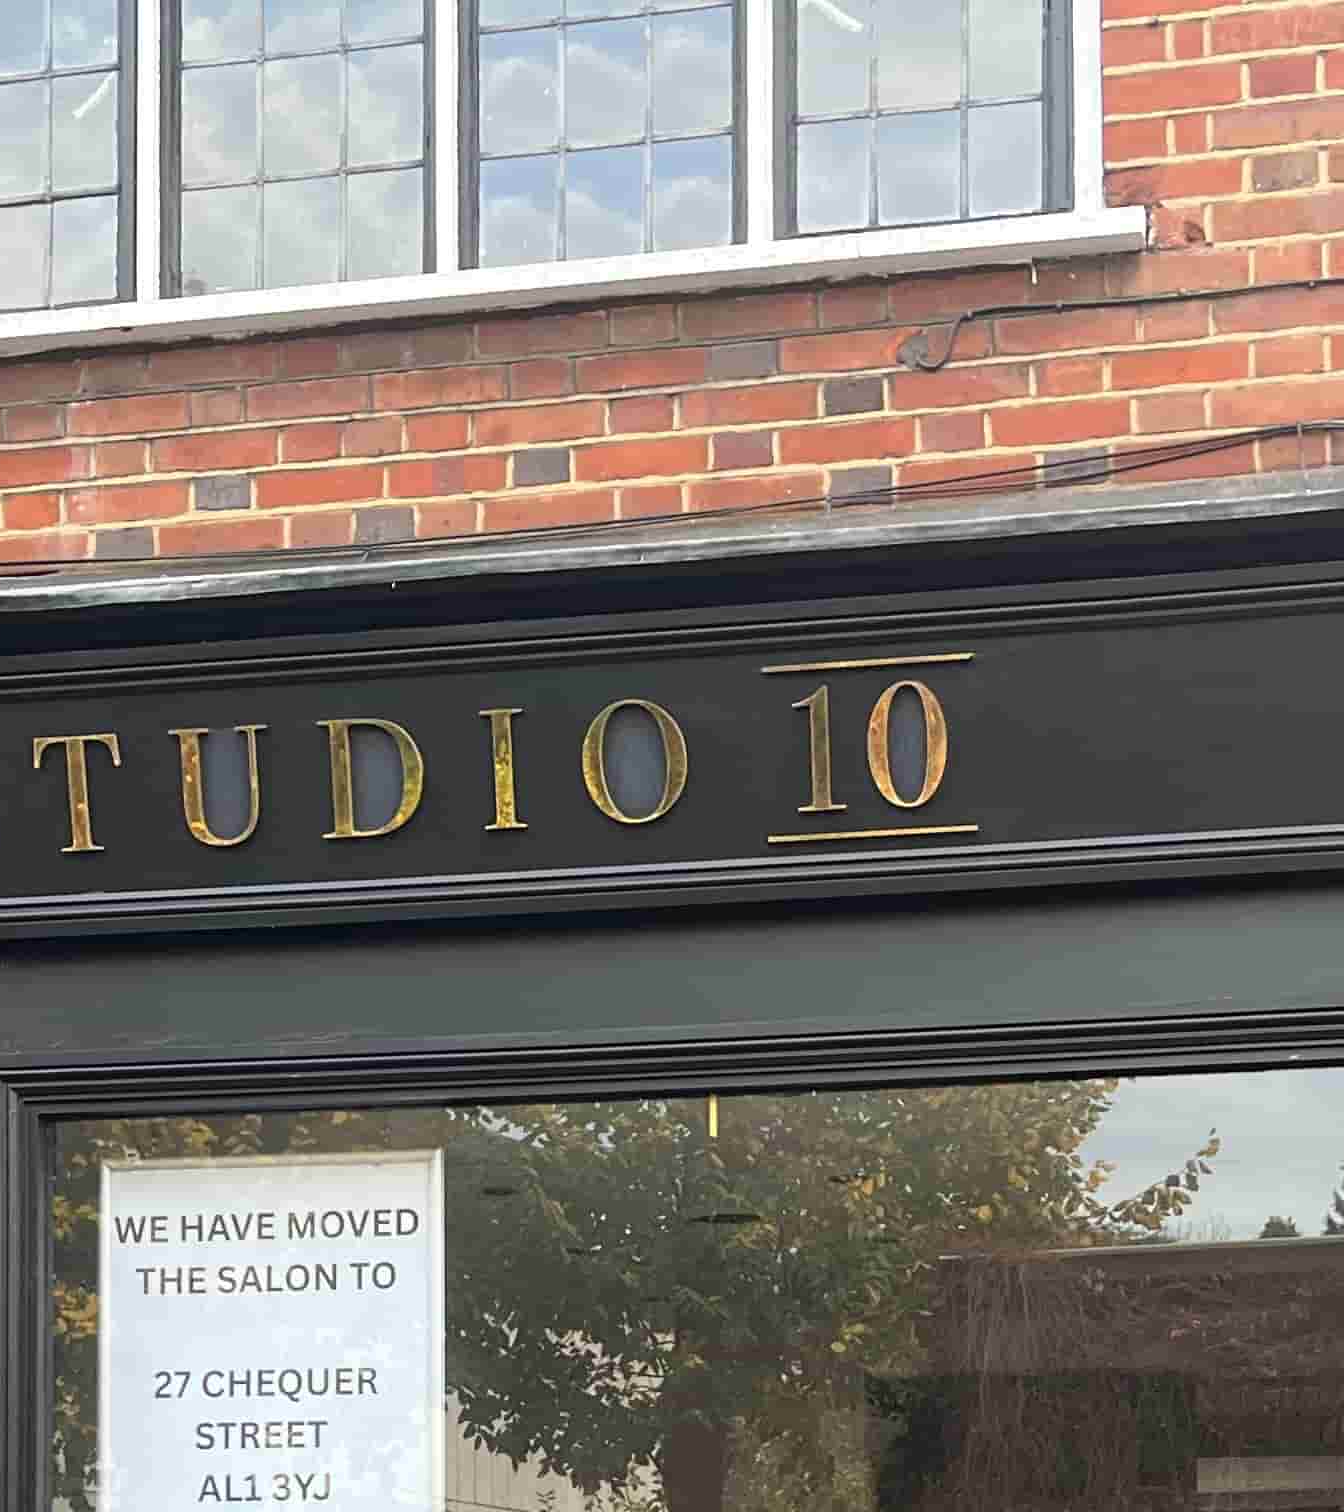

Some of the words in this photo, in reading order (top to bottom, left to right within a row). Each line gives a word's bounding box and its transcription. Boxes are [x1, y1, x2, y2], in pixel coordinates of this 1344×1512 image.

[791, 680, 948, 813] 10
[115, 1215, 168, 1244] WE
[181, 1212, 274, 1242] HAVE
[288, 1208, 419, 1240] MOVED
[136, 1266, 207, 1295] THE
[217, 1263, 338, 1294] SALON
[351, 1262, 396, 1290] TO
[154, 1371, 191, 1399] 27
[202, 1367, 378, 1400] CHEQUER
[195, 1420, 328, 1450] STREET
